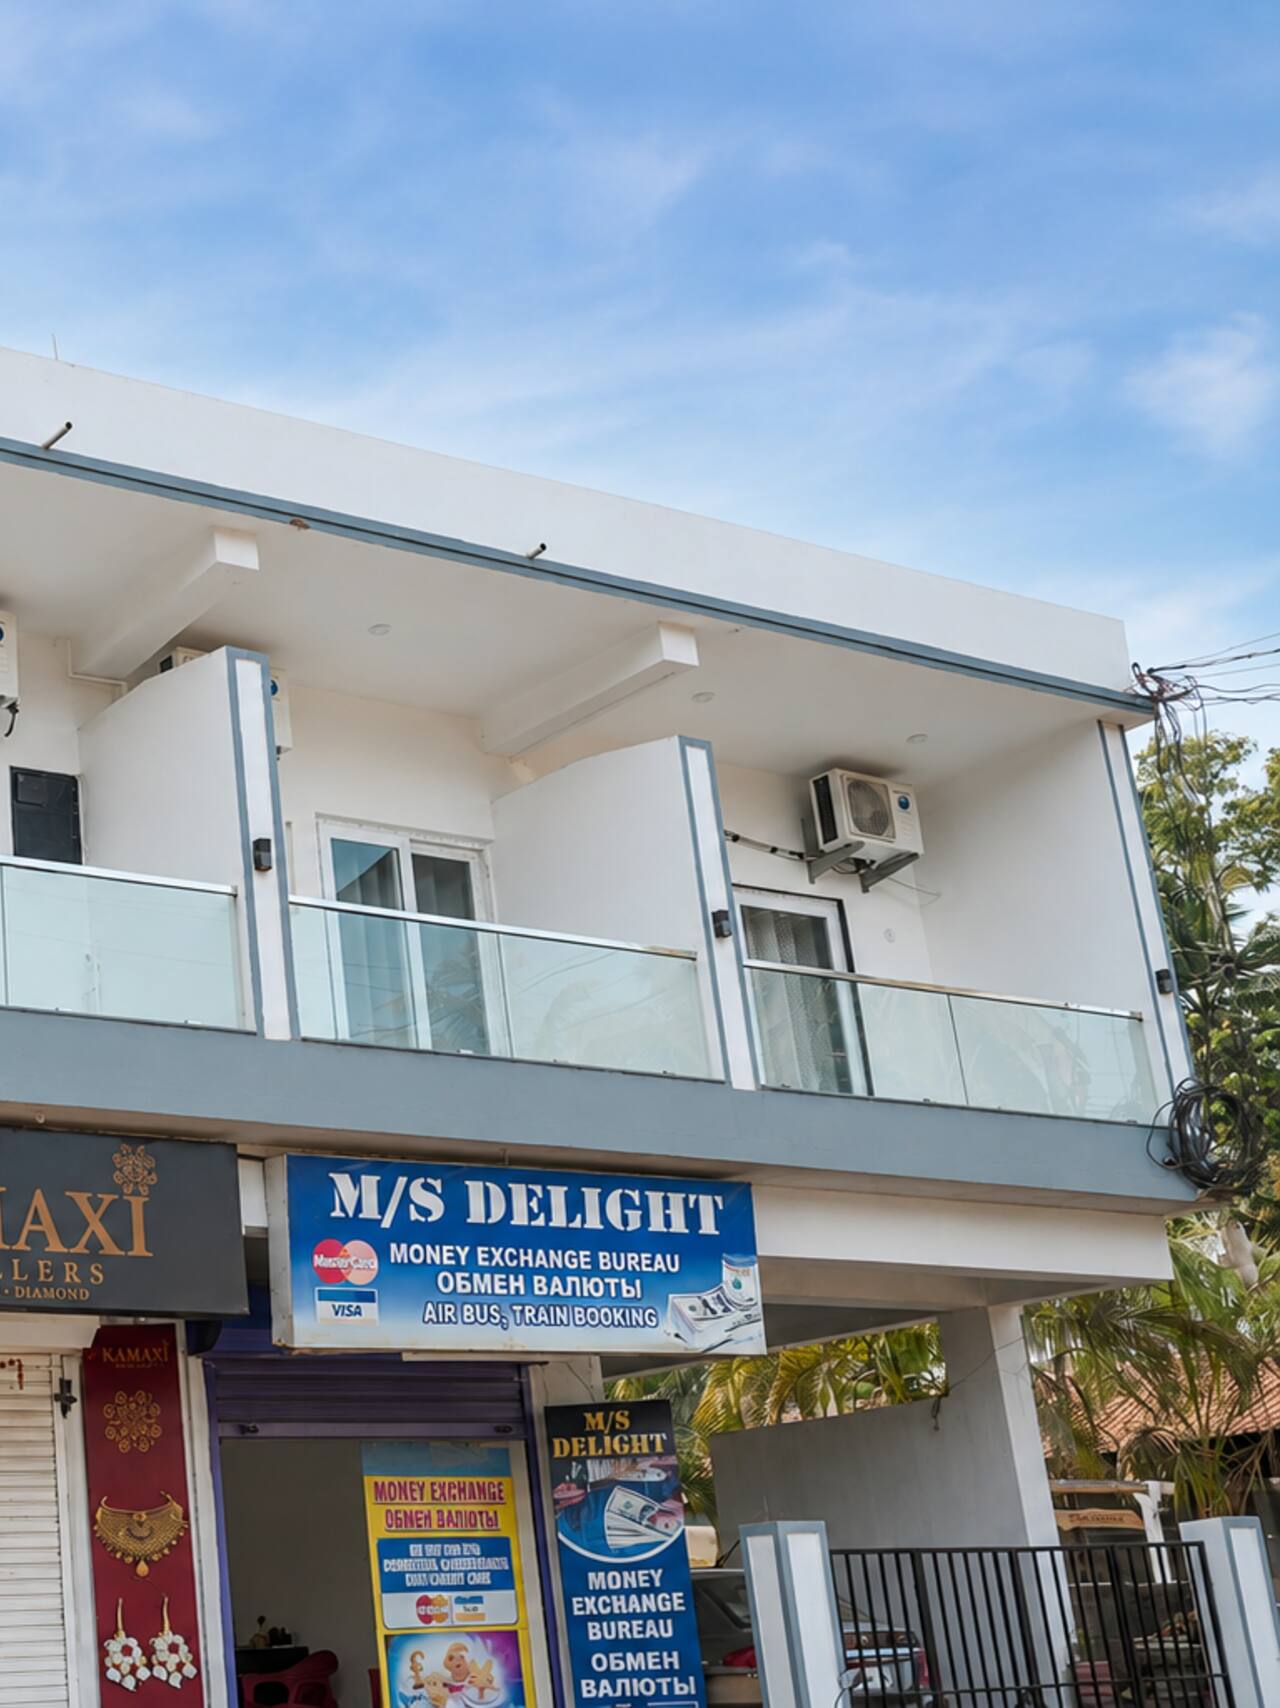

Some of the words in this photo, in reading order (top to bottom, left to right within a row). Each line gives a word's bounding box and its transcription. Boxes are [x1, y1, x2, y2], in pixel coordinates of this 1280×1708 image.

[328, 1172, 446, 1229] M/S
[463, 1179, 724, 1235] DELIGHT
[390, 1241, 470, 1267] MONEY
[476, 1246, 593, 1270] EXCHANGE
[598, 1251, 680, 1273] BUREAU
[15, 1286, 90, 1301] DIAMOND
[437, 1271, 526, 1296] ОБМЕН
[533, 1275, 642, 1299] ВАЛЮТЫ
[331, 1303, 363, 1317] VISA
[423, 1301, 457, 1323] AIR
[462, 1304, 509, 1330] BUS,
[512, 1304, 570, 1326] TRAIN
[574, 1306, 659, 1328] BOOKING
[583, 1409, 631, 1435] M/S
[552, 1432, 667, 1459] DELIGHT
[374, 1480, 426, 1502] MONEY
[430, 1480, 505, 1502] EXCHANGE
[587, 1568, 664, 1591] MONEY
[572, 1592, 686, 1617] EXCHANGE
[587, 1619, 673, 1642] BUREAU
[590, 1650, 680, 1673] ОБМЕН
[580, 1675, 696, 1699] ВАЛЮТЫ
